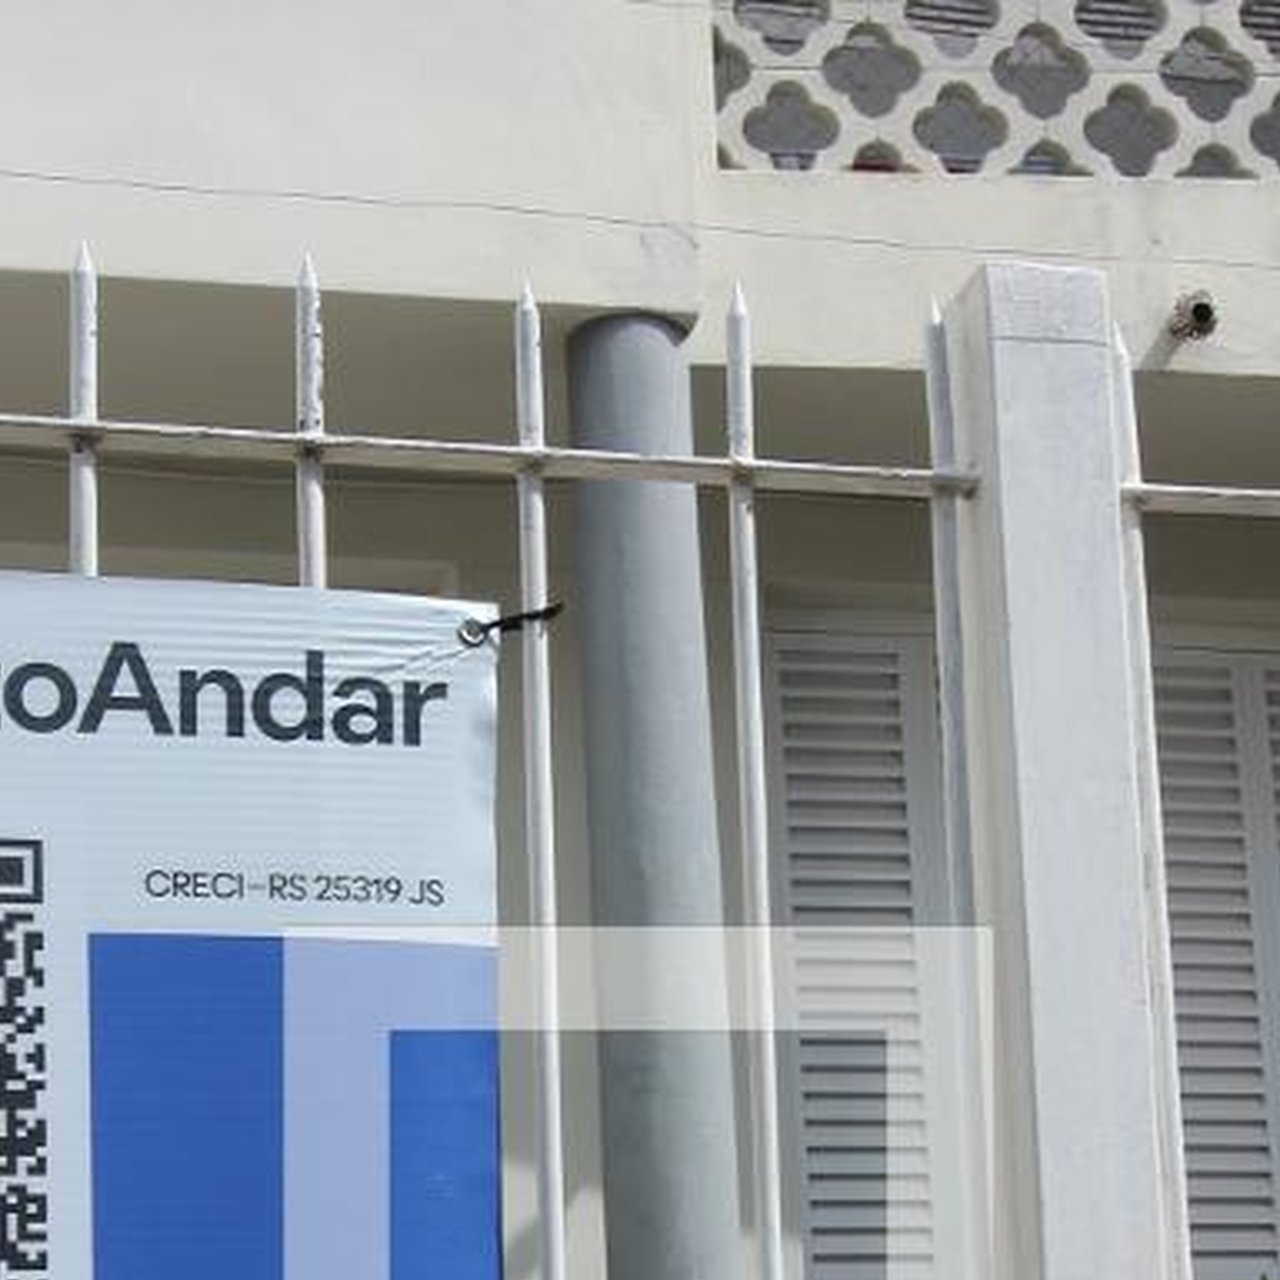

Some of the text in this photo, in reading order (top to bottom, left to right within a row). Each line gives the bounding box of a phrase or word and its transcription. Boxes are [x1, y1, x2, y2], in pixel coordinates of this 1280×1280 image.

[144, 869, 446, 907] CRECI-RS 25319 JS
